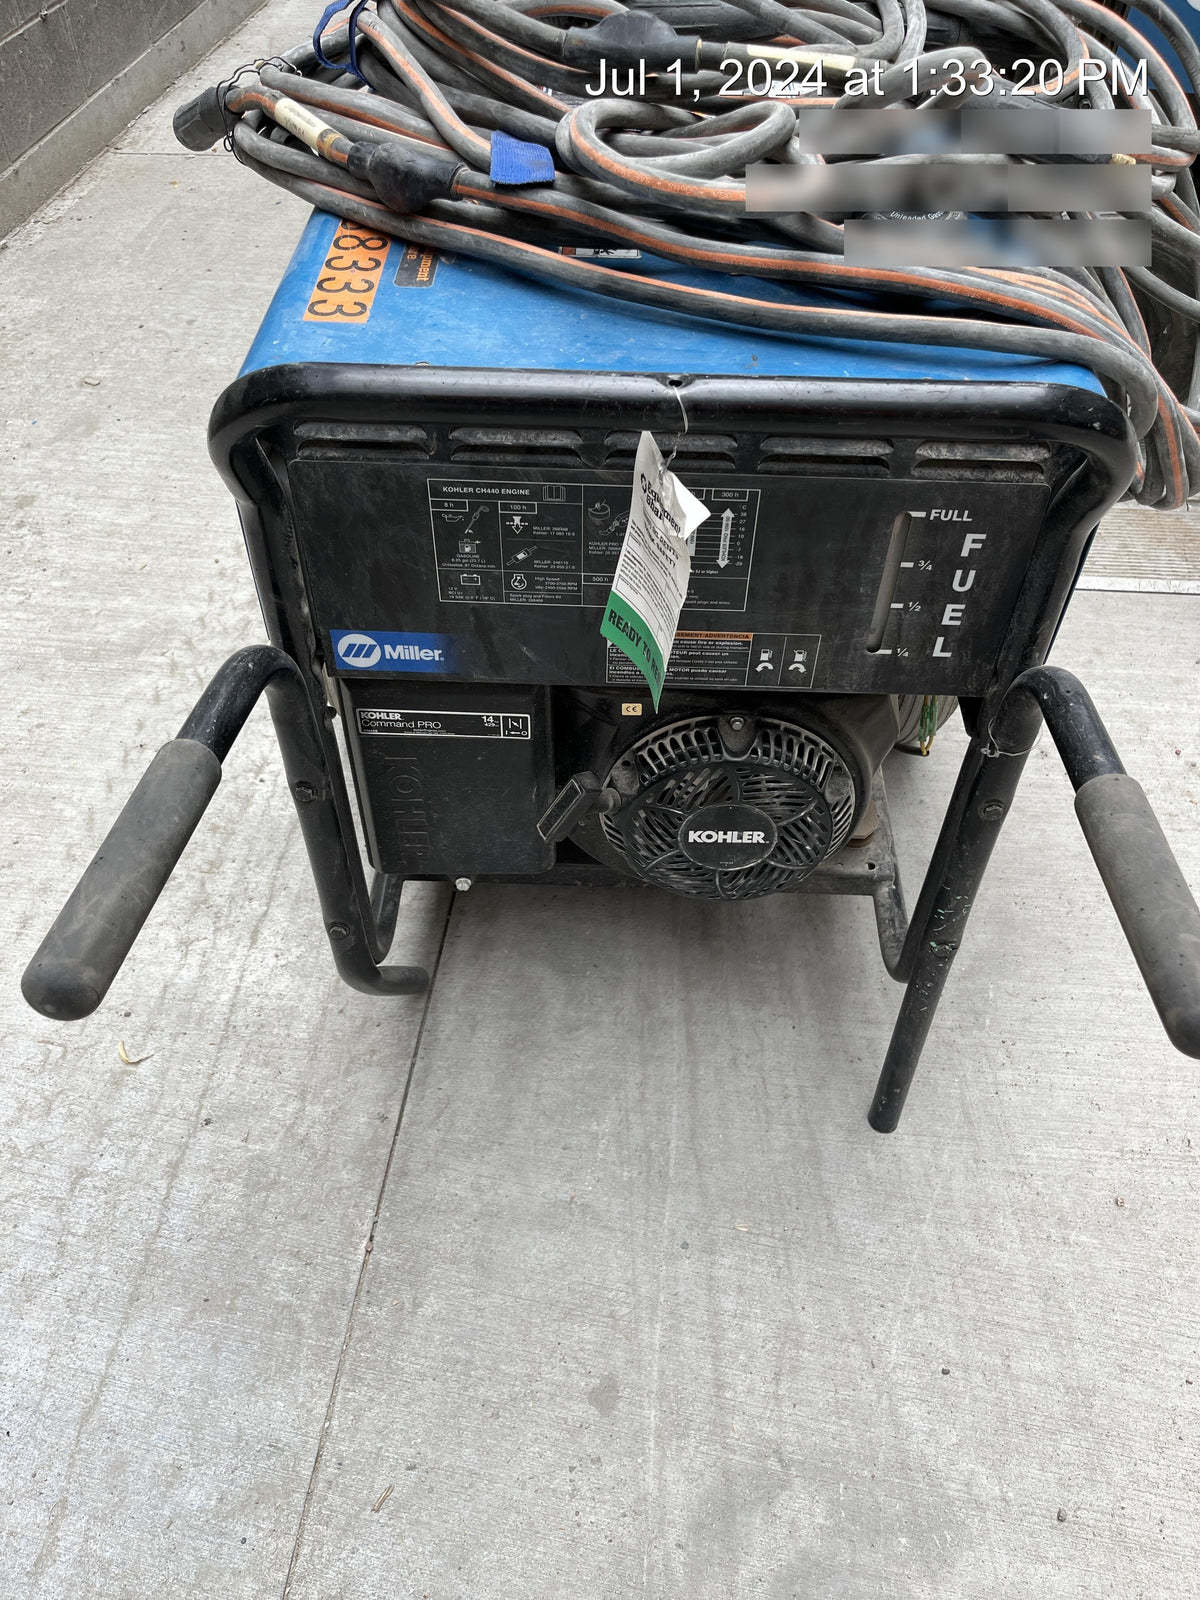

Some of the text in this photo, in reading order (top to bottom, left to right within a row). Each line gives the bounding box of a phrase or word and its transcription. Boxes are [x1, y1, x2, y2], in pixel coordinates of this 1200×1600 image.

[475, 487, 500, 495] CH440
[501, 488, 530, 496] ENGINE
[929, 509, 974, 522] FULL
[608, 609, 642, 647] READY
[642, 641, 651, 663] TO
[360, 711, 402, 720] KOHLER
[481, 715, 494, 723] 14
[361, 719, 442, 729] Command PRO
[688, 830, 766, 844] KOHLER
